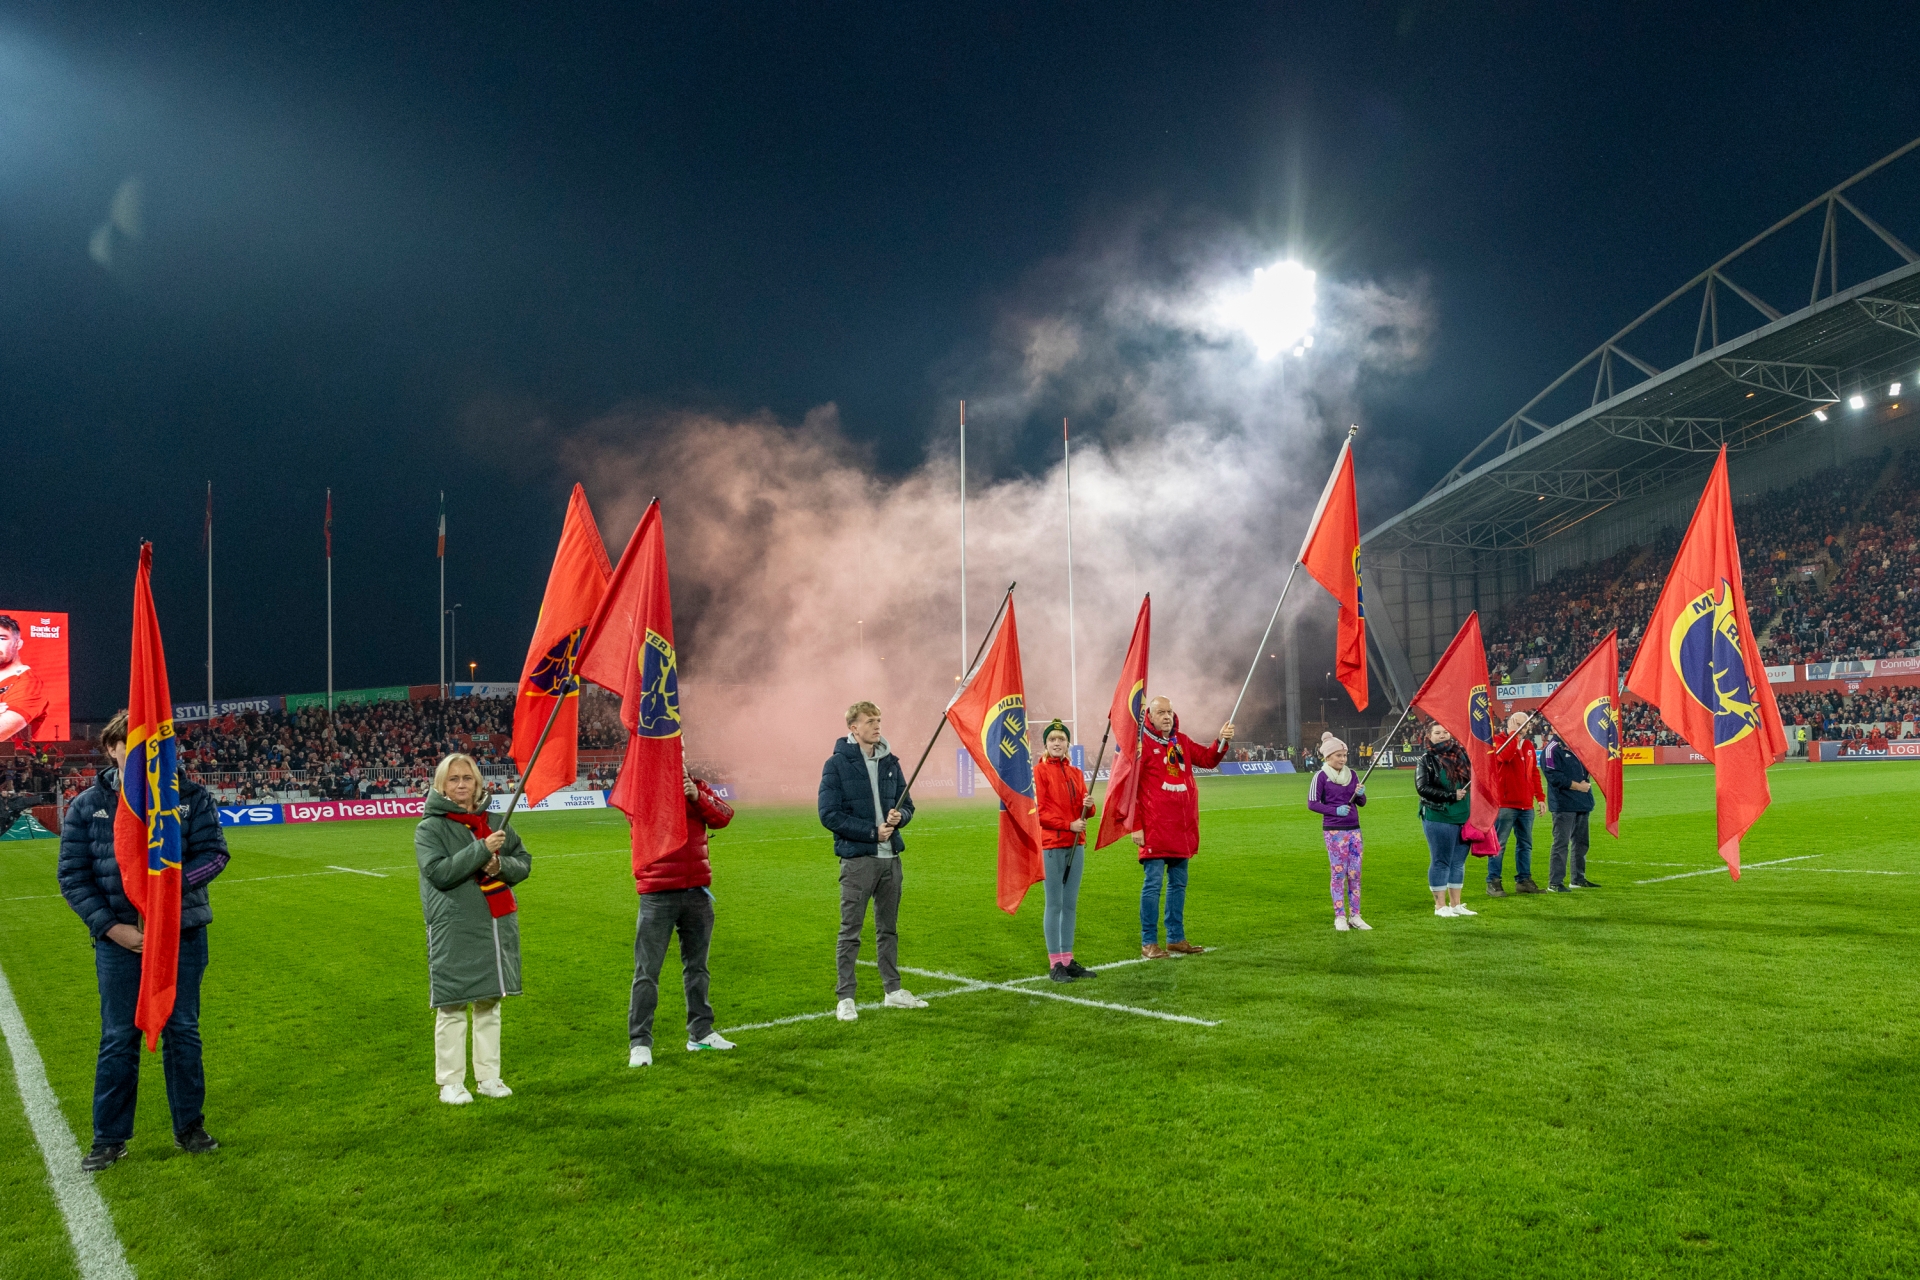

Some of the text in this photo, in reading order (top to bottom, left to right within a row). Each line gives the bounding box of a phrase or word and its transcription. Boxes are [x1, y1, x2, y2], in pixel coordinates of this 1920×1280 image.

[646, 631, 668, 651] TER
[1880, 658, 1920, 668] Connolly
[1497, 686, 1526, 696] PAQIT
[176, 700, 269, 718] STYLE SPORTS
[1242, 762, 1273, 773] currys
[219, 808, 273, 824] YS
[291, 804, 334, 821] laya
